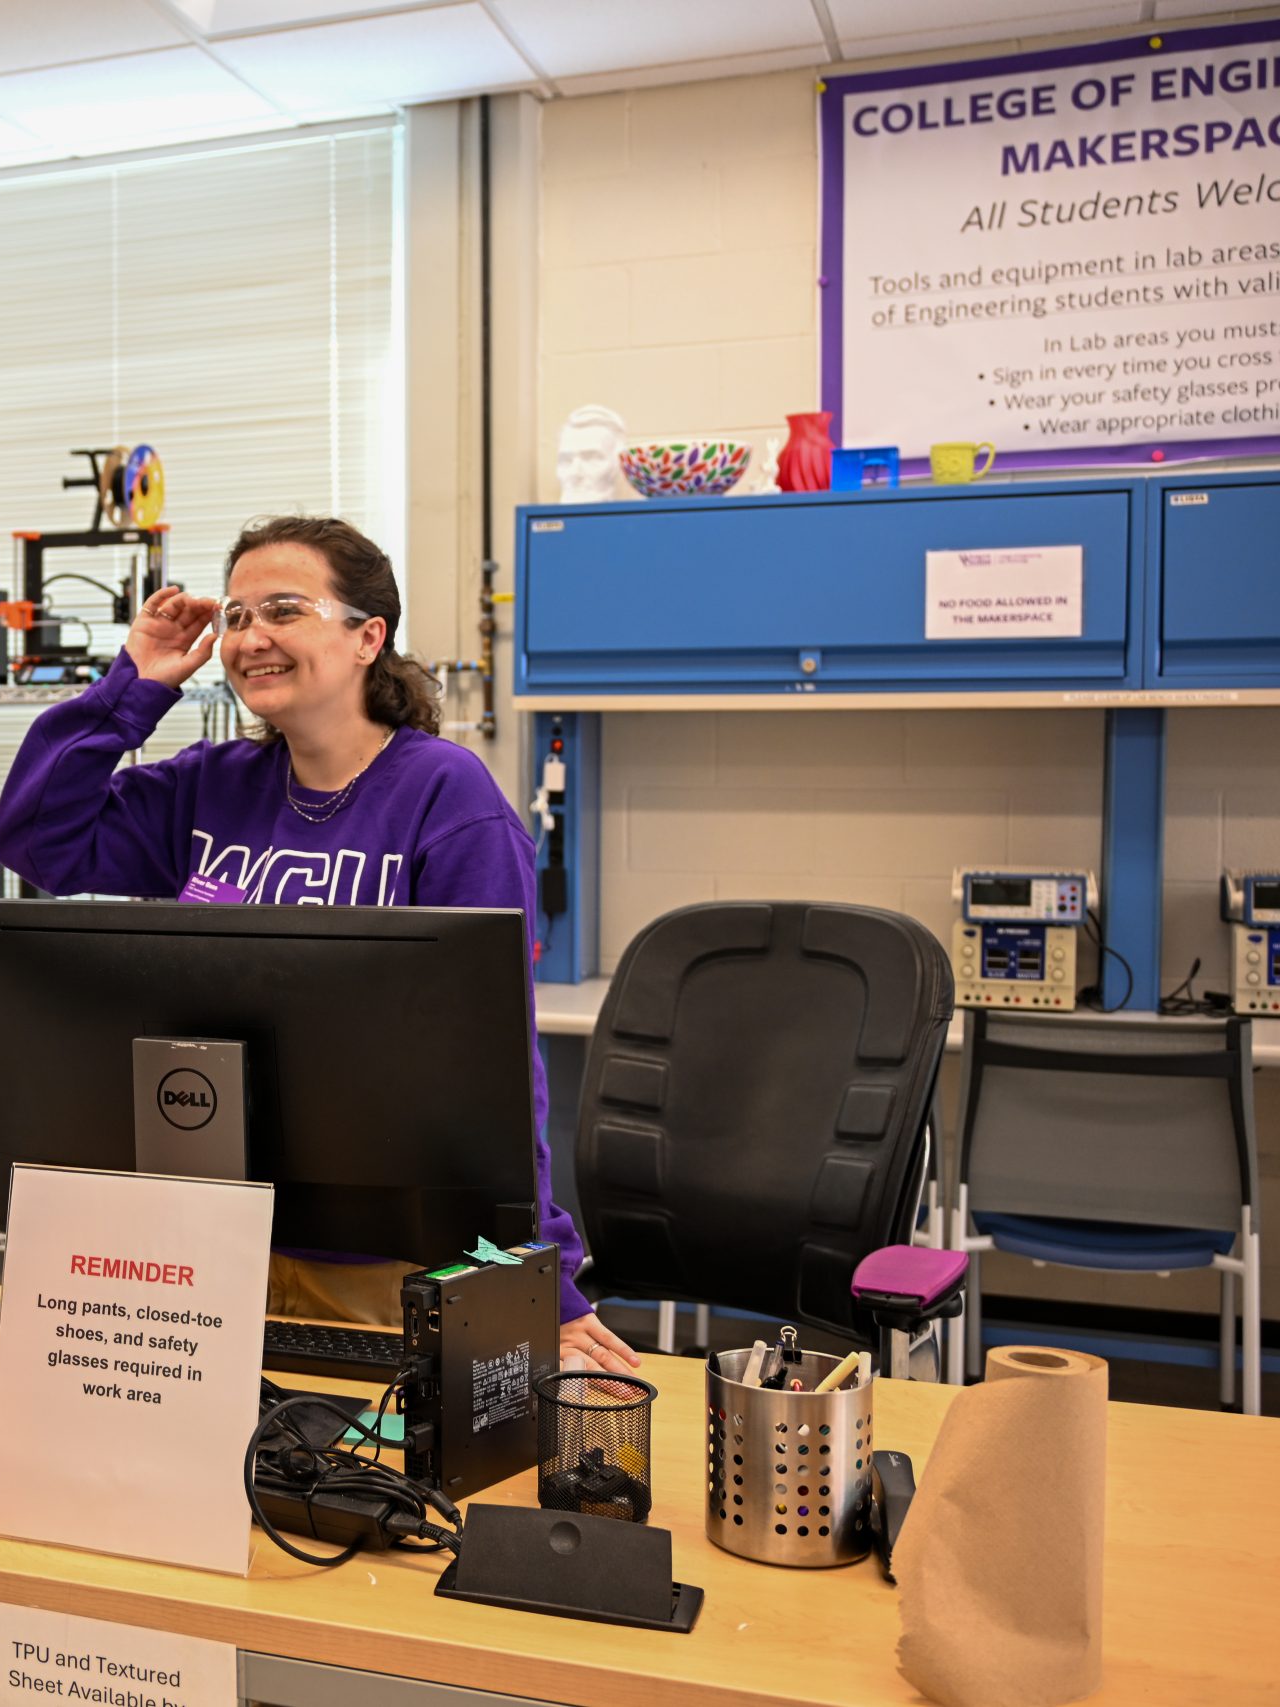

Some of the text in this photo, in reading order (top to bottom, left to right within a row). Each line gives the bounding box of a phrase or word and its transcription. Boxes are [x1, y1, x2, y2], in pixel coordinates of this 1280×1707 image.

[852, 56, 1280, 137] COLLEGE OF ENGI
[960, 201, 1007, 233] All
[1018, 189, 1179, 227] Students
[869, 242, 1280, 294] Tools and equipment in lab areas
[872, 270, 1280, 327] of Engineering students with vali
[1043, 338, 1062, 353] In
[1070, 332, 1107, 352] Lab
[1113, 331, 1169, 348] areas
[1176, 328, 1215, 349] you
[992, 366, 1033, 389] Sign
[1039, 364, 1057, 380] in
[1062, 363, 1117, 383] every
[1122, 357, 1167, 375] time
[1173, 356, 1211, 377] you
[1217, 350, 1272, 368] cross
[1003, 378, 1280, 412] Wear your safety glasses pr
[1038, 402, 1279, 436] Wear appropriate clothi
[939, 596, 1068, 609] NO FOOD ALLOWED IN
[952, 612, 1054, 624] THE MAKERSPACE
[164, 1090, 210, 1107] DELL
[70, 1254, 195, 1287] REMINDER
[37, 1293, 223, 1328] Long pants, closed-toe
[55, 1323, 198, 1357] shoes, and safety
[47, 1349, 202, 1382] glasses required in
[82, 1382, 162, 1404] work area
[11, 1640, 181, 1688] TPU and Textured
[8, 1669, 63, 1695] Sheet
[67, 1680, 156, 1707] Available
